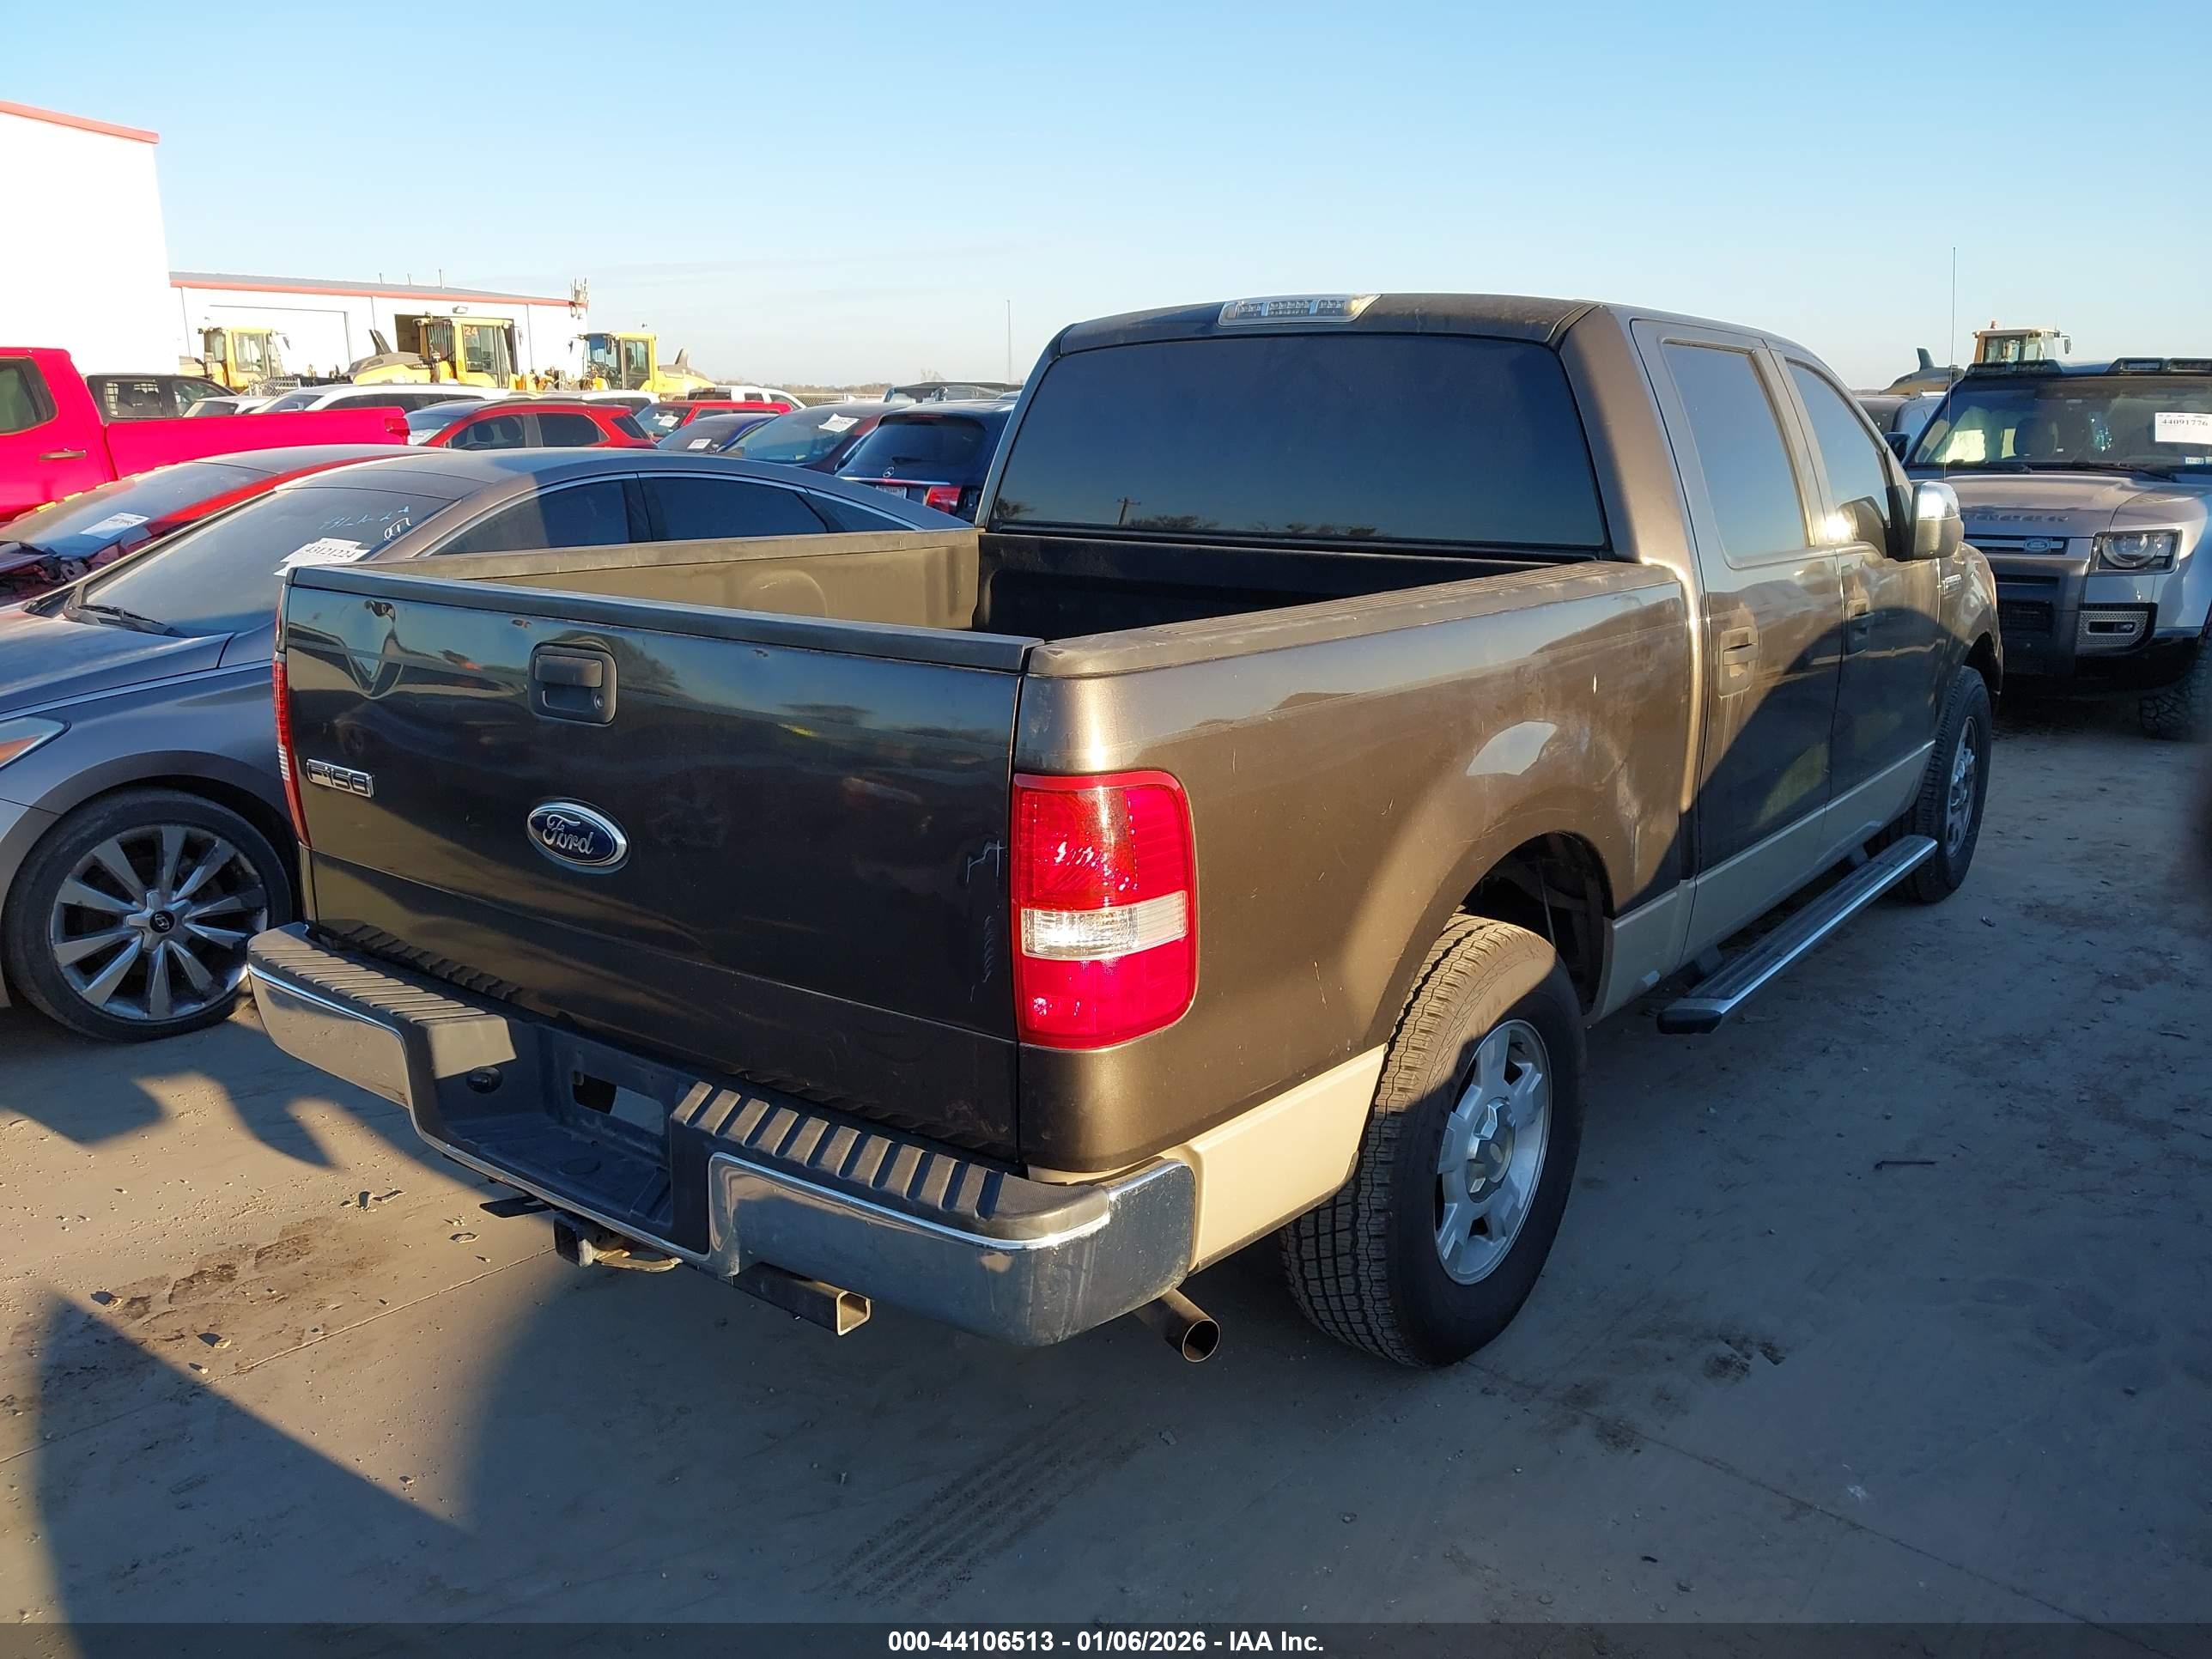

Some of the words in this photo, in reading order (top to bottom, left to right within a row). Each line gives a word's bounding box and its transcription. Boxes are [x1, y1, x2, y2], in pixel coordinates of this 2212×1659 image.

[465, 325, 478, 337] 24
[2162, 418, 2209, 427] 44091776
[542, 813, 595, 855] Ford
